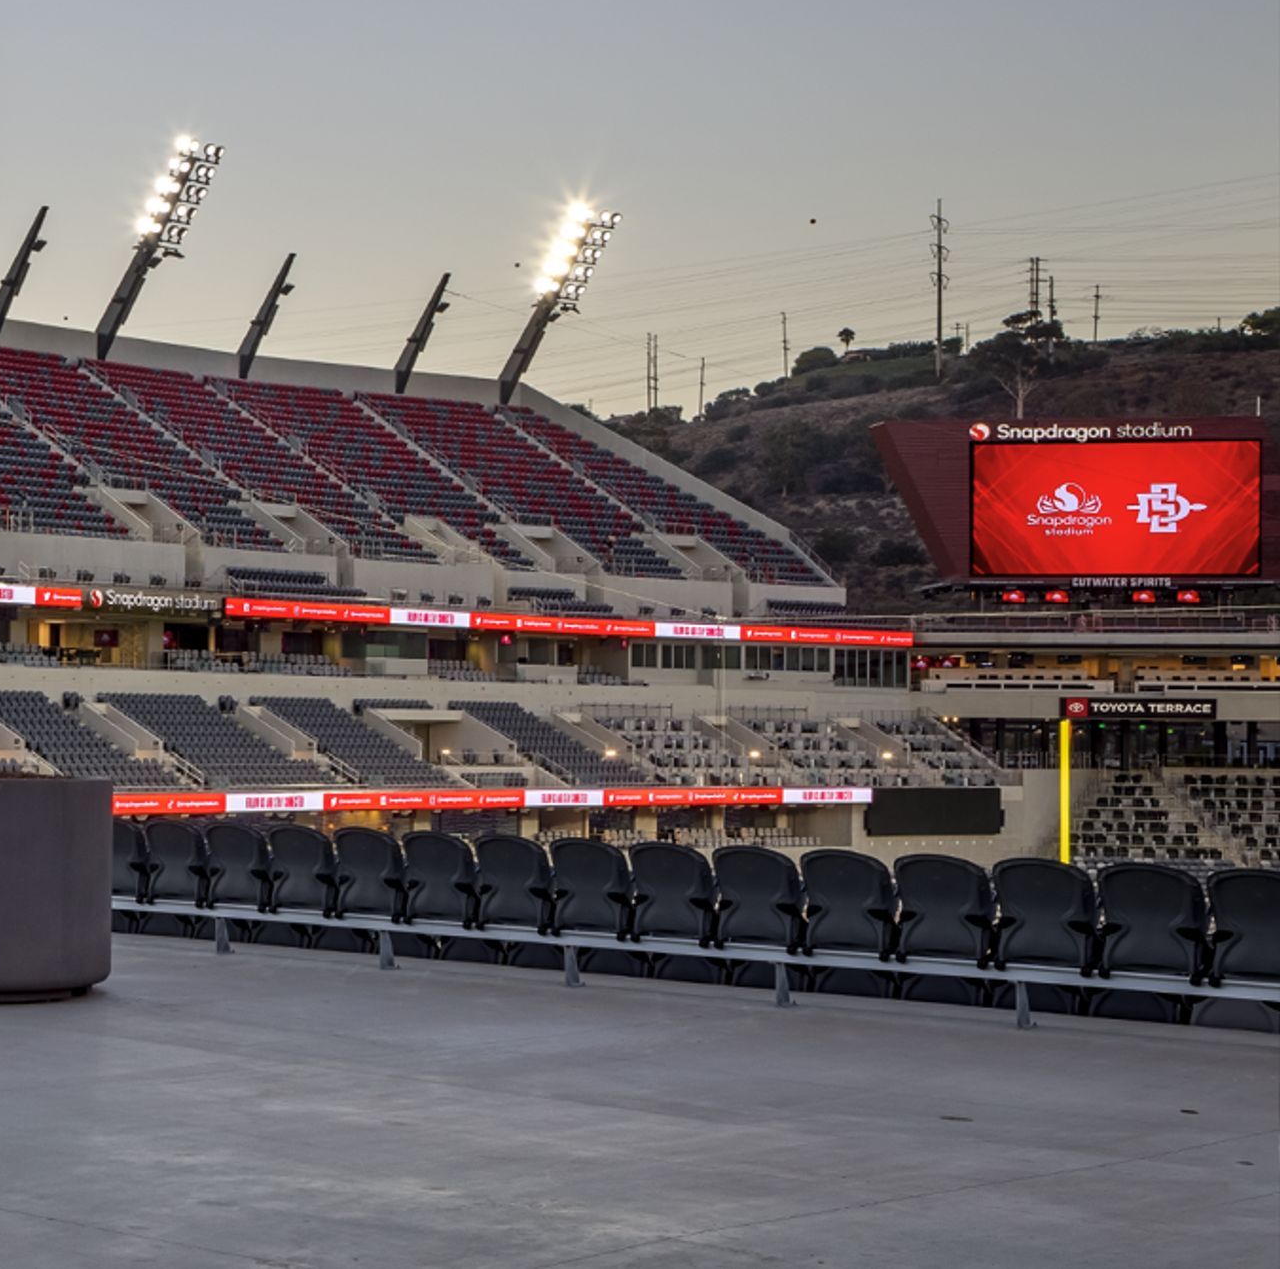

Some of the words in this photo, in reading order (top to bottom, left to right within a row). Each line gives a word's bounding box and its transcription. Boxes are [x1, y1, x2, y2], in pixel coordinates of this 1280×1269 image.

[997, 423, 1111, 443] Snapdragon
[1116, 422, 1193, 438] stadium
[1026, 513, 1112, 527] Snapdragon
[1045, 528, 1094, 536] stadium
[1130, 577, 1171, 587] SPIRITS
[105, 589, 173, 612] Snapdragon
[175, 594, 218, 610] stadium
[1091, 702, 1145, 713] TOYOTA
[1148, 703, 1212, 713] TERRACE
